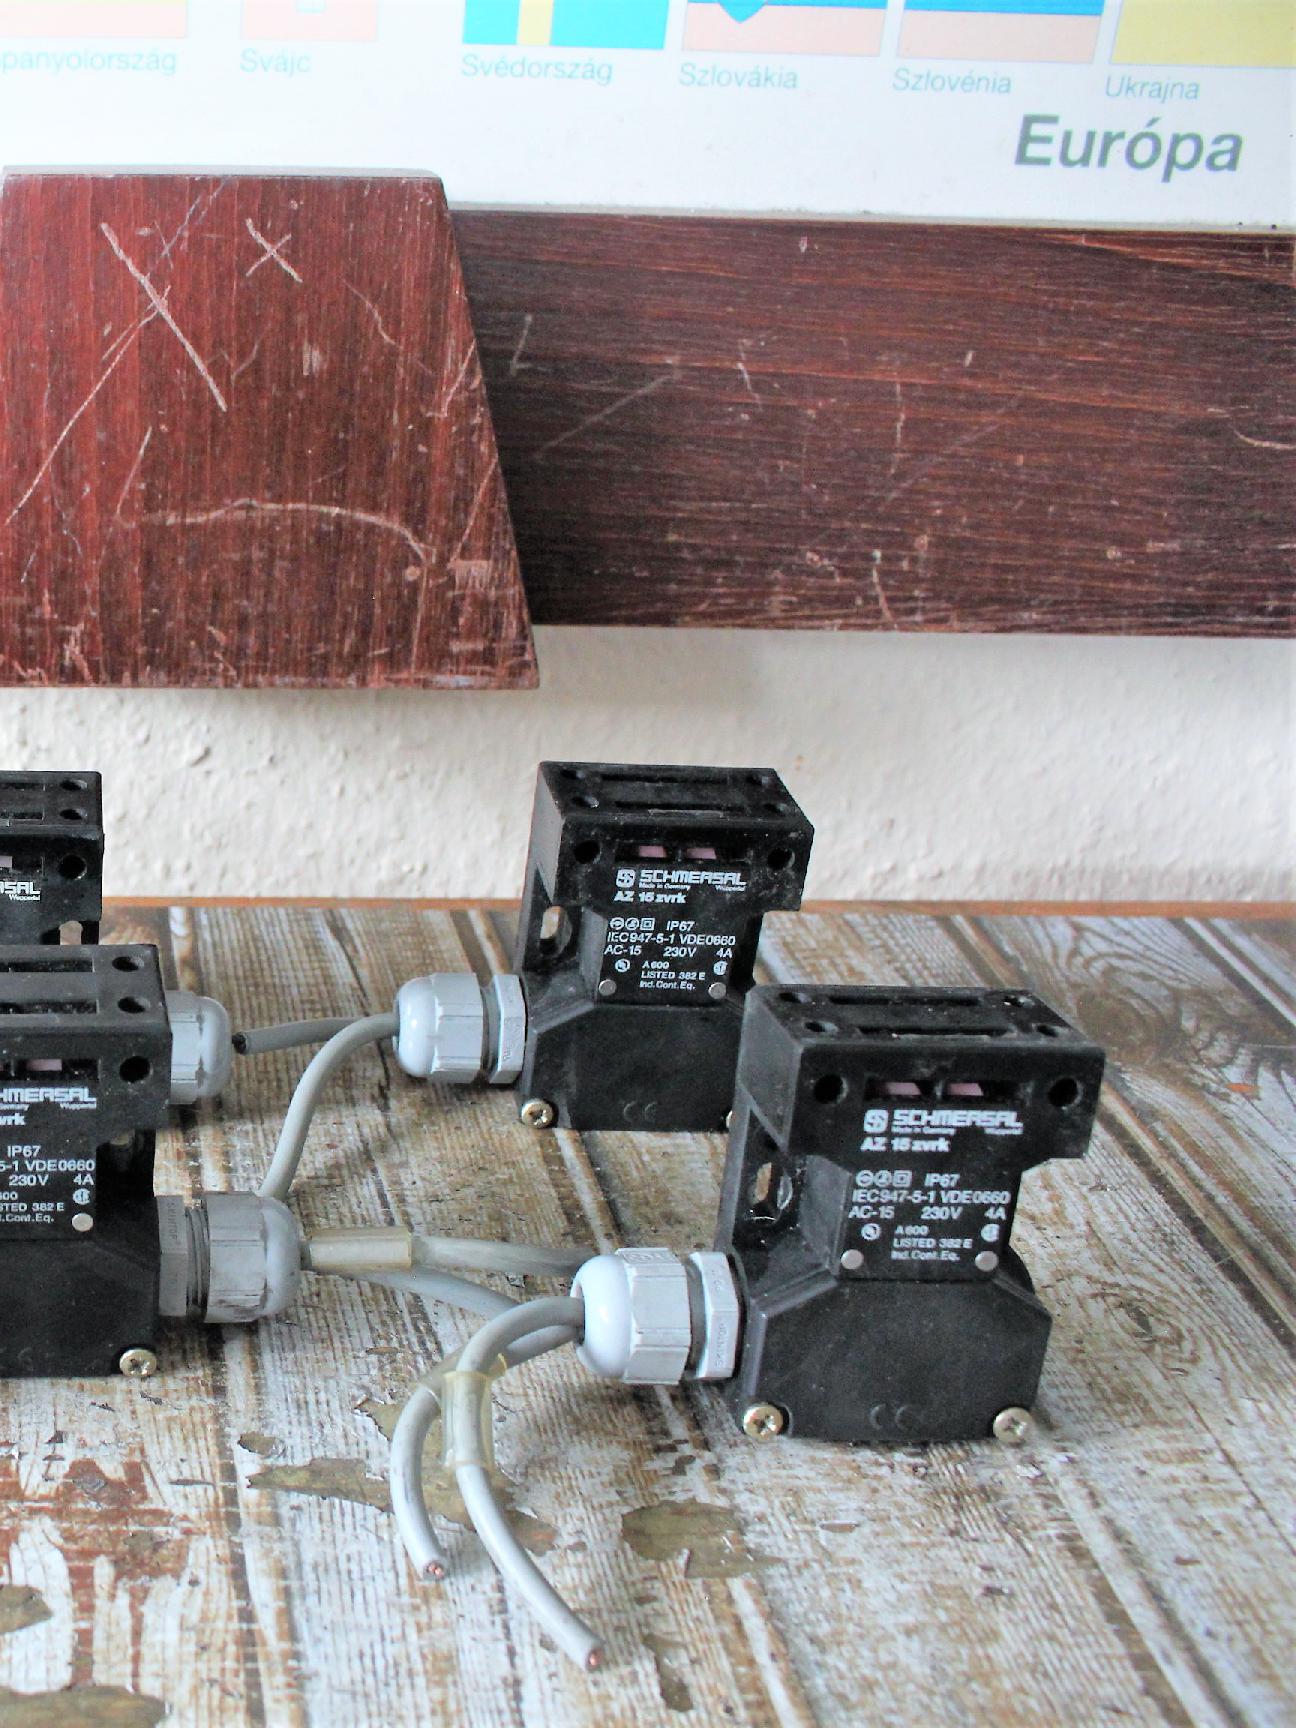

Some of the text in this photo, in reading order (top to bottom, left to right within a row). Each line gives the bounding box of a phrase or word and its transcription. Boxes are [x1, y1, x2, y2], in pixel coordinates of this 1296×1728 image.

[239, 48, 311, 77] Svájc
[462, 53, 613, 86] Svédország
[678, 62, 799, 90] Szlovákia
[892, 67, 1011, 95] Szlovénia
[1105, 76, 1200, 104] Ukrajna
[1015, 113, 1243, 183] Európa
[639, 870, 747, 885] SCHMERSAL
[614, 891, 634, 901] AZ
[666, 920, 695, 931] IP67
[604, 945, 642, 955] AC-15
[716, 948, 733, 958] 4A
[641, 970, 675, 979] LISTED
[7, 1146, 41, 1157] IP67
[74, 1174, 94, 1185] 4A
[925, 1173, 960, 1187] IP67
